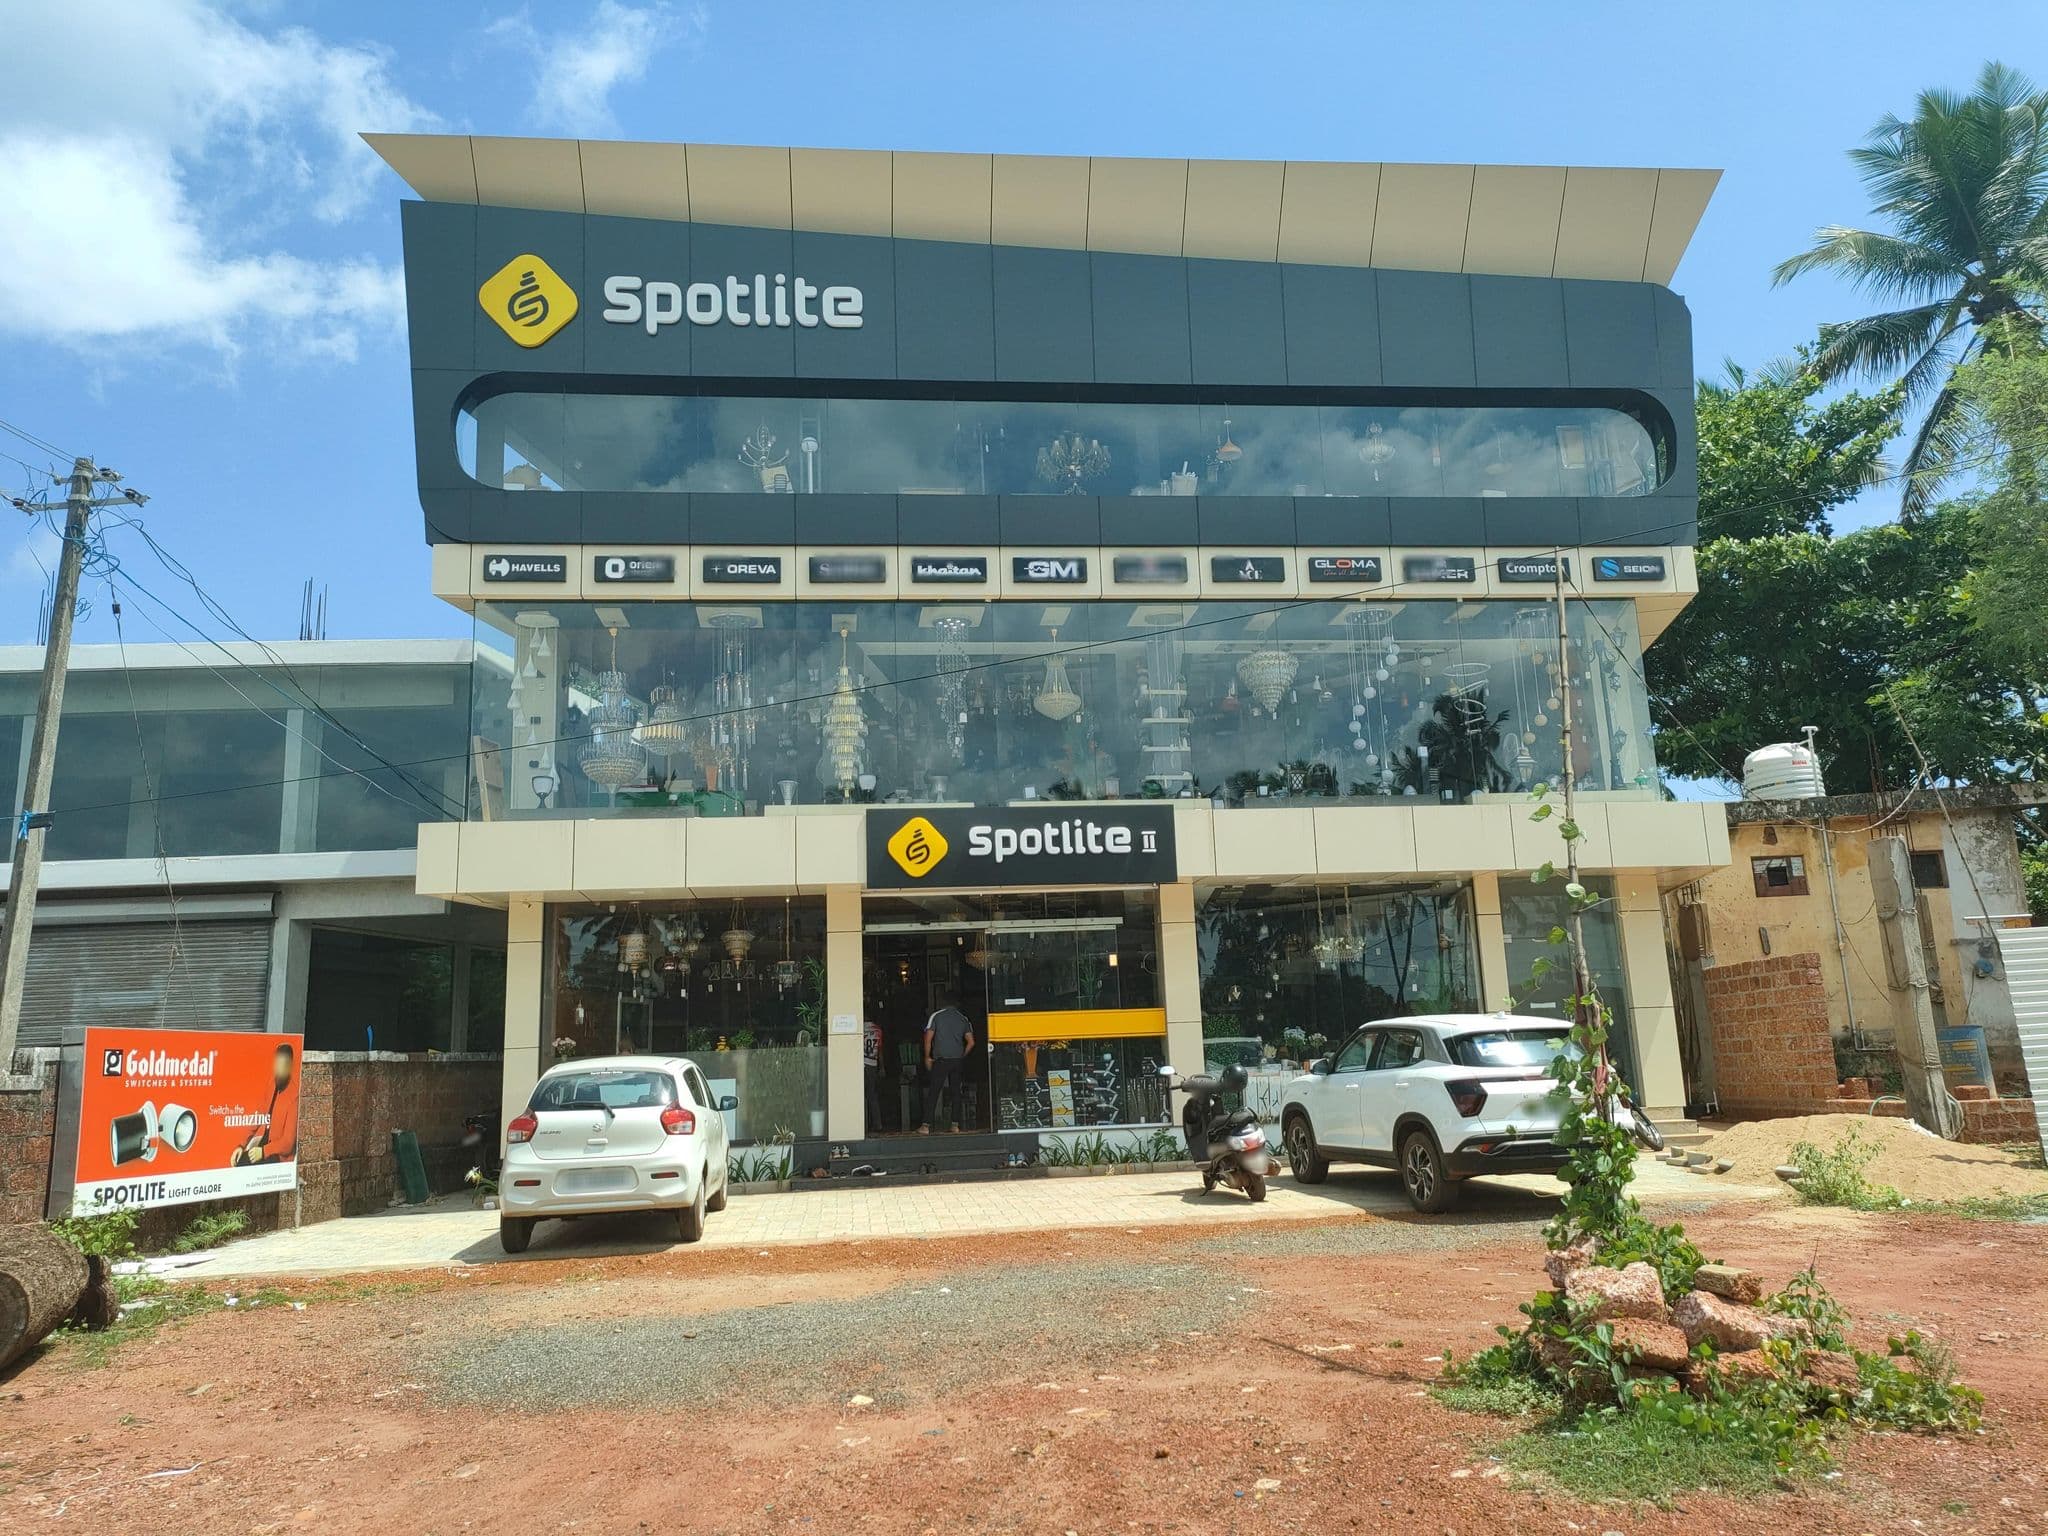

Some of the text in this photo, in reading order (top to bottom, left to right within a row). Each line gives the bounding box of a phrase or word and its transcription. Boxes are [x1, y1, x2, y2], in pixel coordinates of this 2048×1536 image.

[603, 273, 864, 336] Spotlite
[511, 563, 561, 572] HAVELLS
[727, 564, 777, 574] OREVA
[916, 563, 982, 577] khaitan
[1025, 561, 1079, 578] GM
[1315, 559, 1377, 569] GLOMA
[968, 818, 1158, 863] Spotlite II
[125, 1048, 214, 1077] Goldmedal
[125, 1079, 167, 1088] SWITCHES
[179, 1079, 212, 1087] SYSTEMS
[223, 1110, 271, 1129] amazing
[94, 1181, 222, 1206] SPOTLITE LIGHT GALORE
